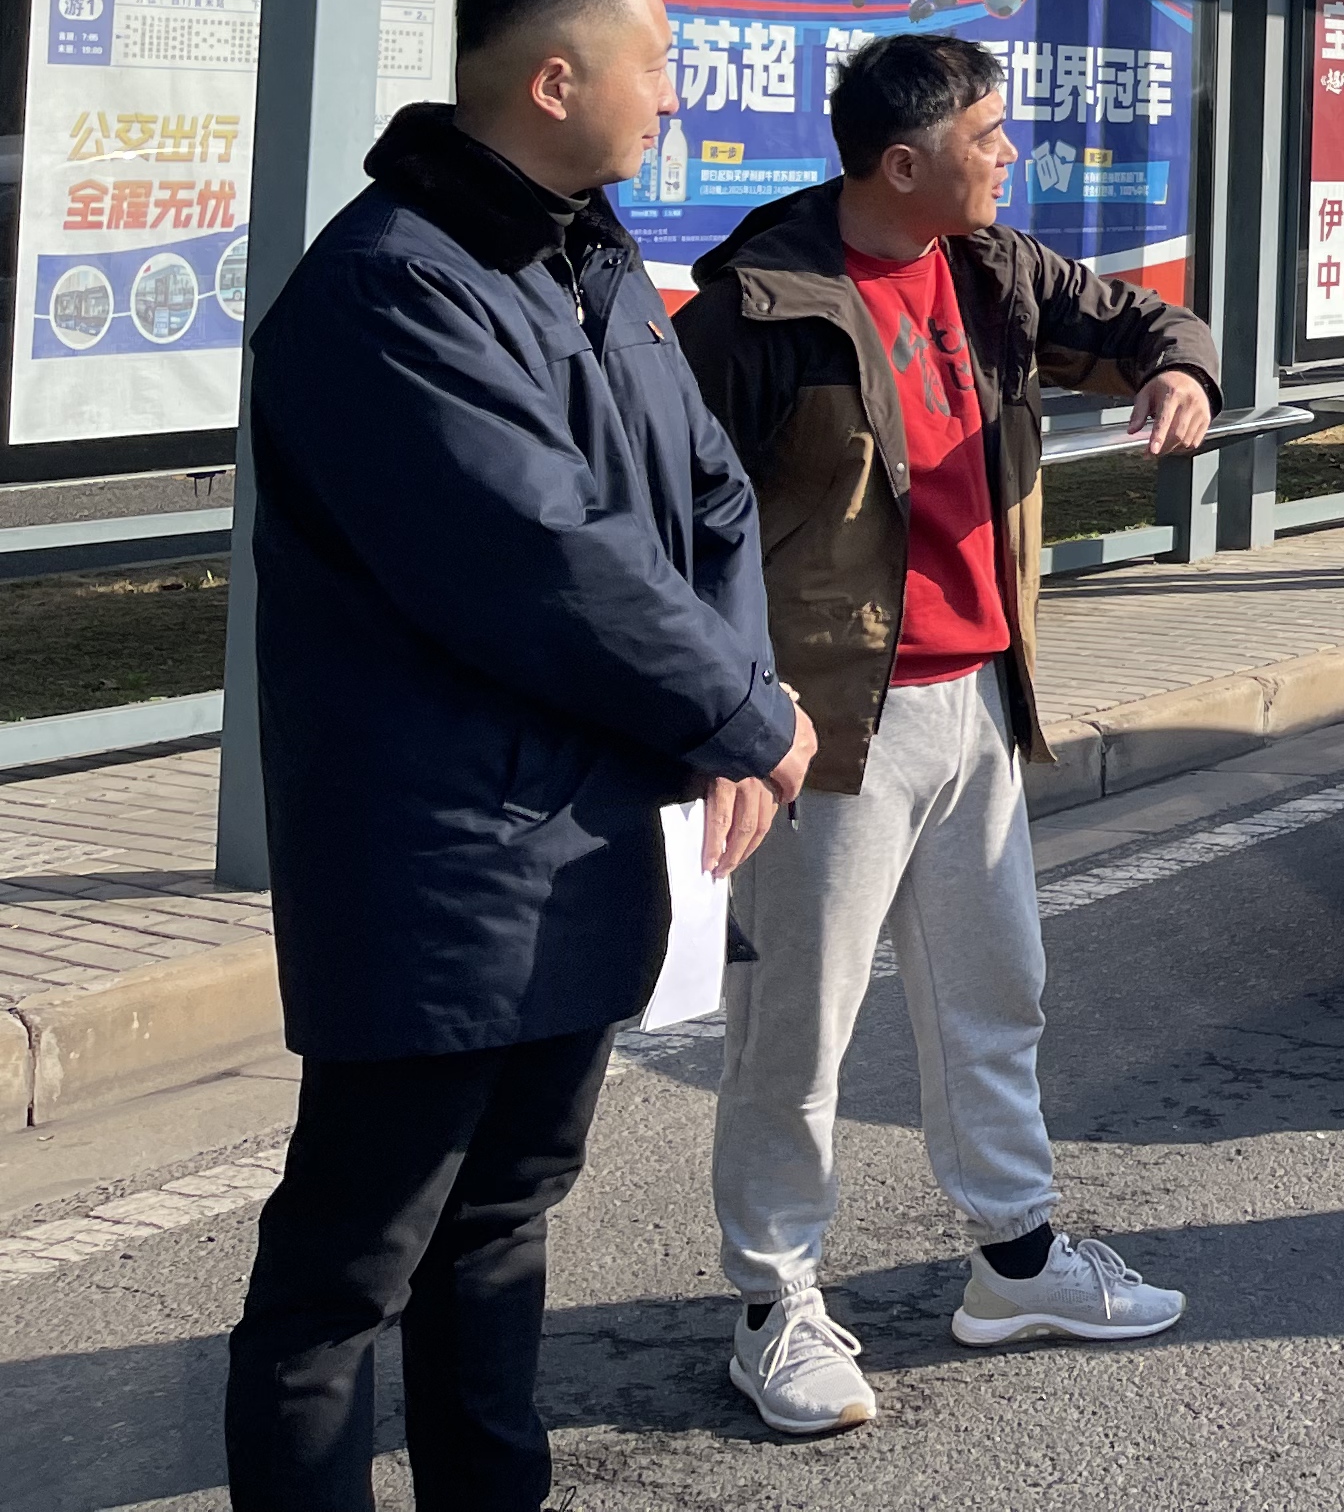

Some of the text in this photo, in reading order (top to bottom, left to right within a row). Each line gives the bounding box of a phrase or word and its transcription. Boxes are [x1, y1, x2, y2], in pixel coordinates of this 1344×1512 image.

[667, 18, 795, 113] 苏超
[66, 111, 241, 164] 公交出行
[63, 178, 237, 231] 全程无忧
